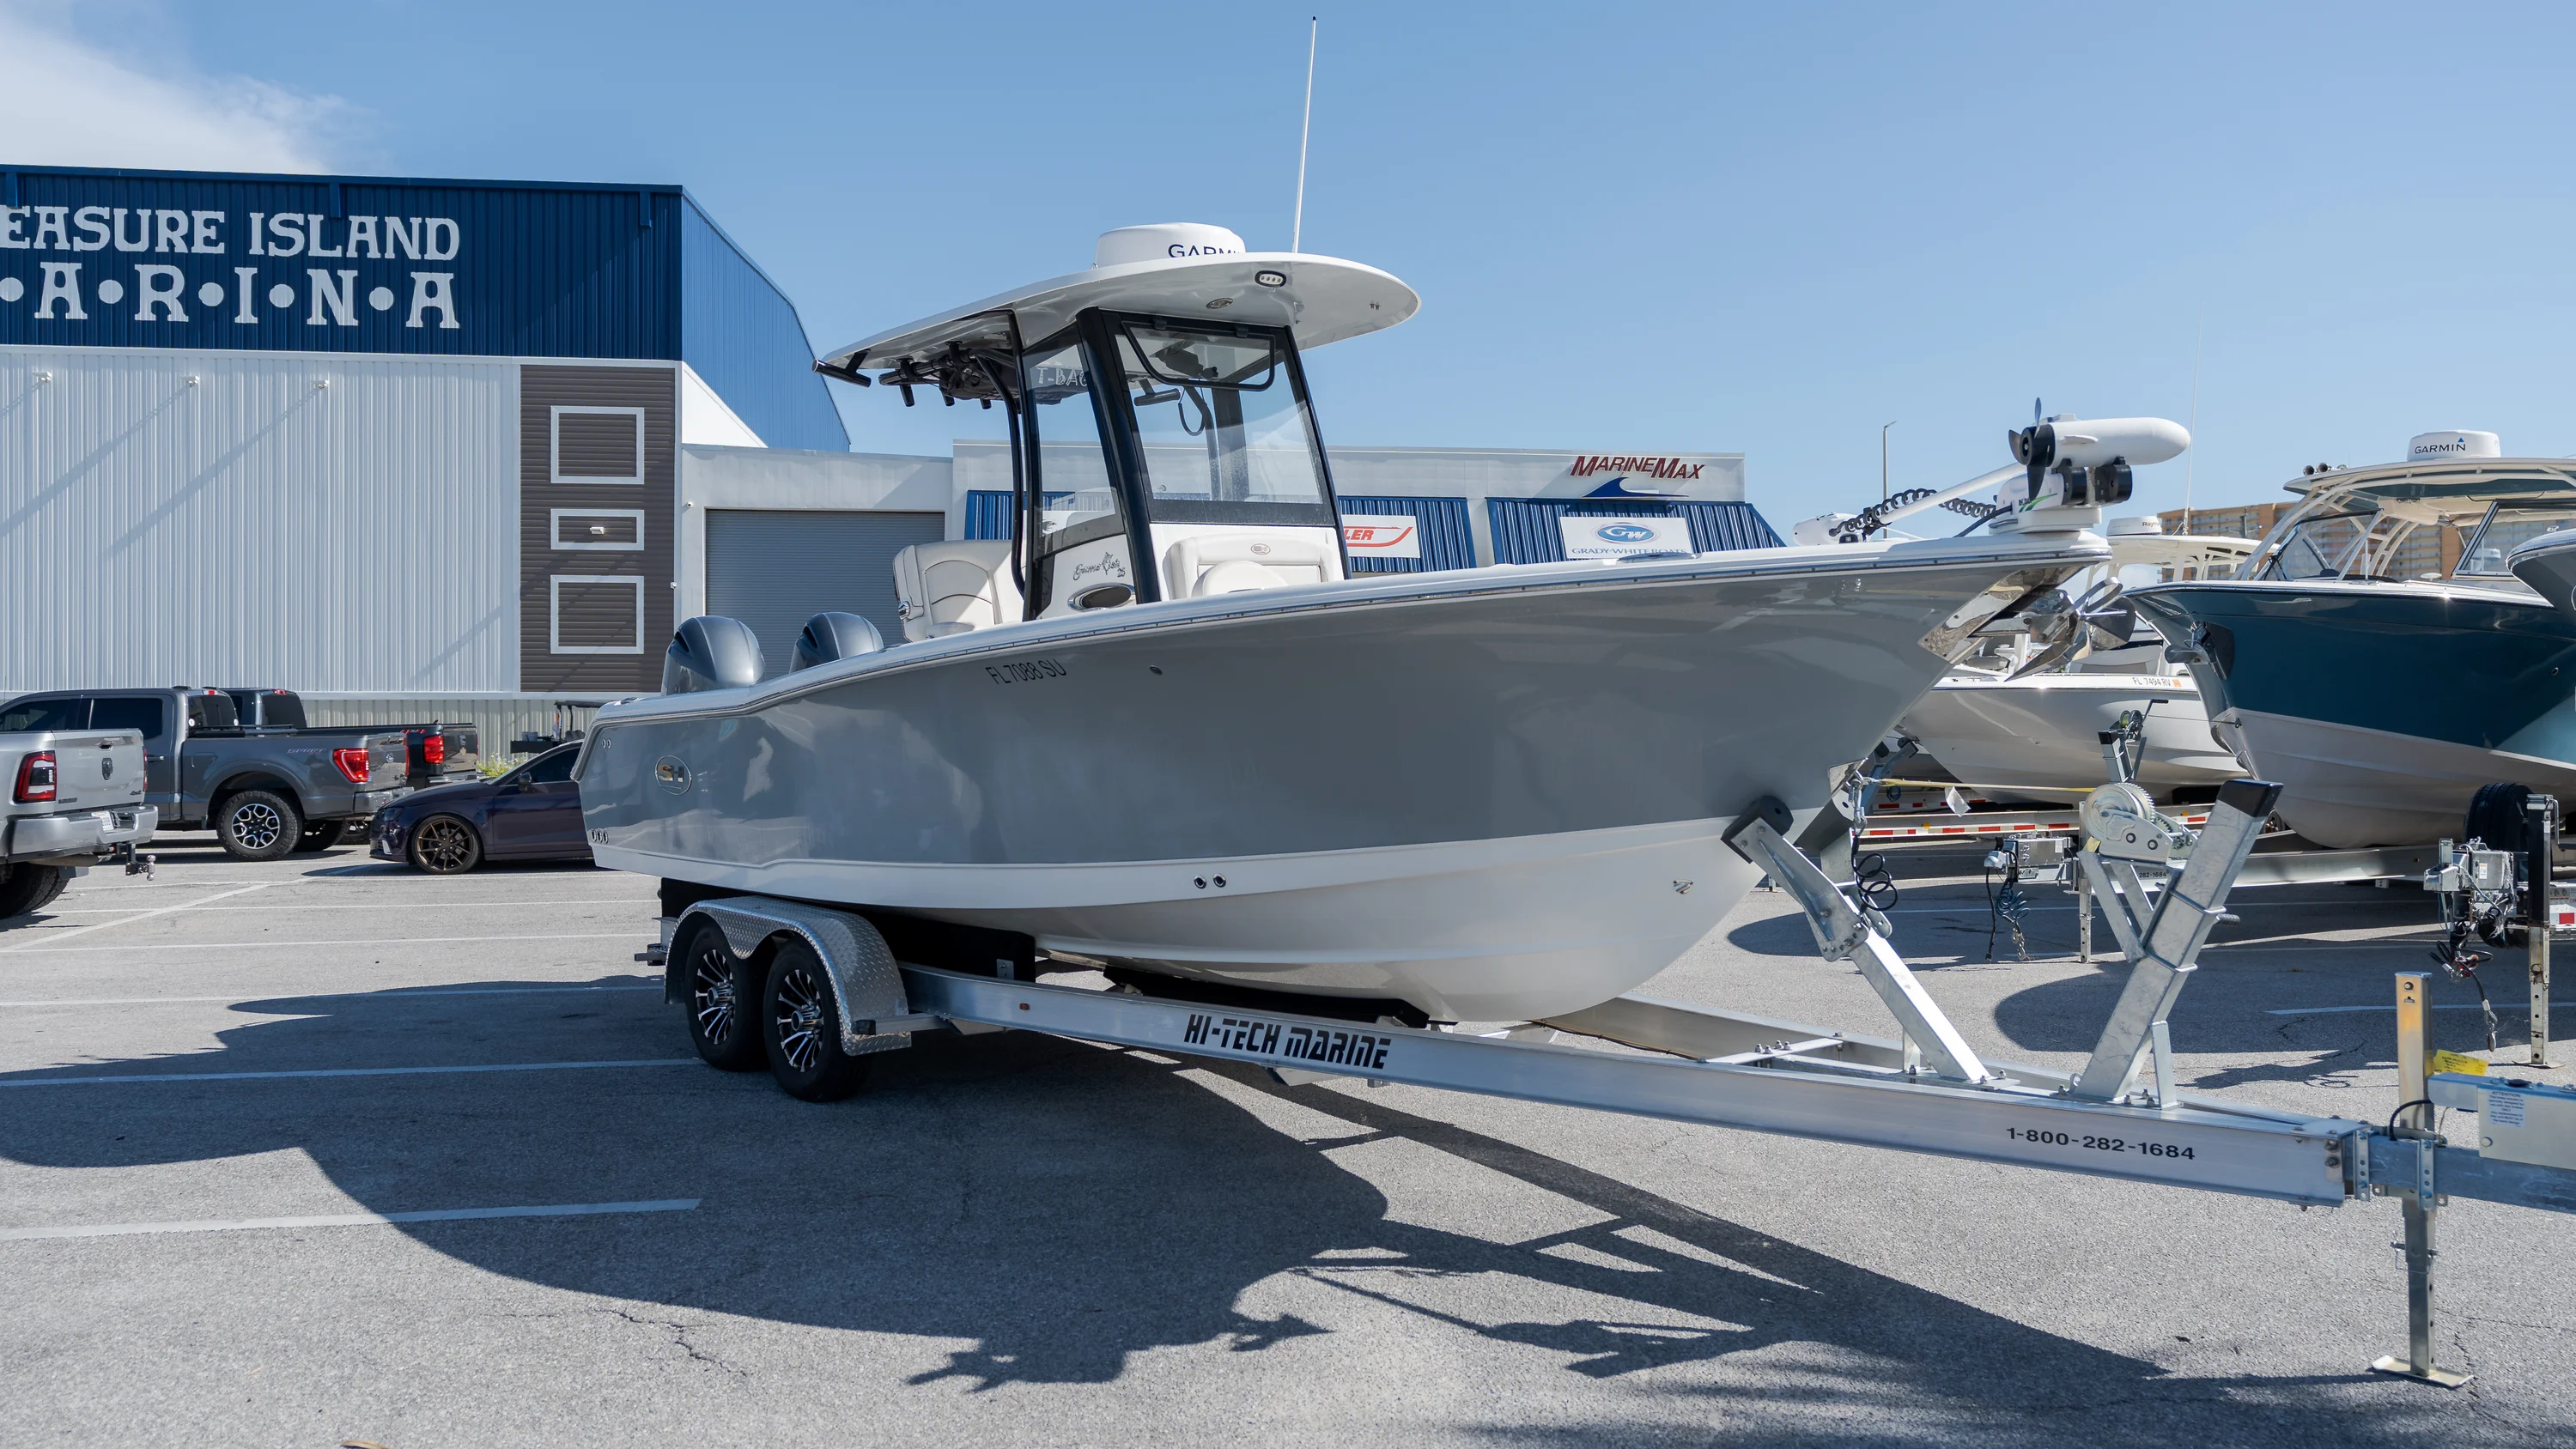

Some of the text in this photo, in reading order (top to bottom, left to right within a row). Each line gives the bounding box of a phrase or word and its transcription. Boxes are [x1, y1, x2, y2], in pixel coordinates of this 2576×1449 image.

[0, 204, 460, 261] EASURE ISLAND
[2415, 444, 2466, 454] GARMIN
[1344, 529, 1374, 541] LER
[1601, 526, 1647, 541] GW
[1571, 547, 1648, 555] GRADY-WHITE
[985, 658, 1066, 685] FL 7088 SU
[2132, 676, 2172, 687] FL 7494 RV
[1183, 1014, 1392, 1070] HI-TECH MARINE
[2006, 1127, 2196, 1160] 1-800-282-1684
